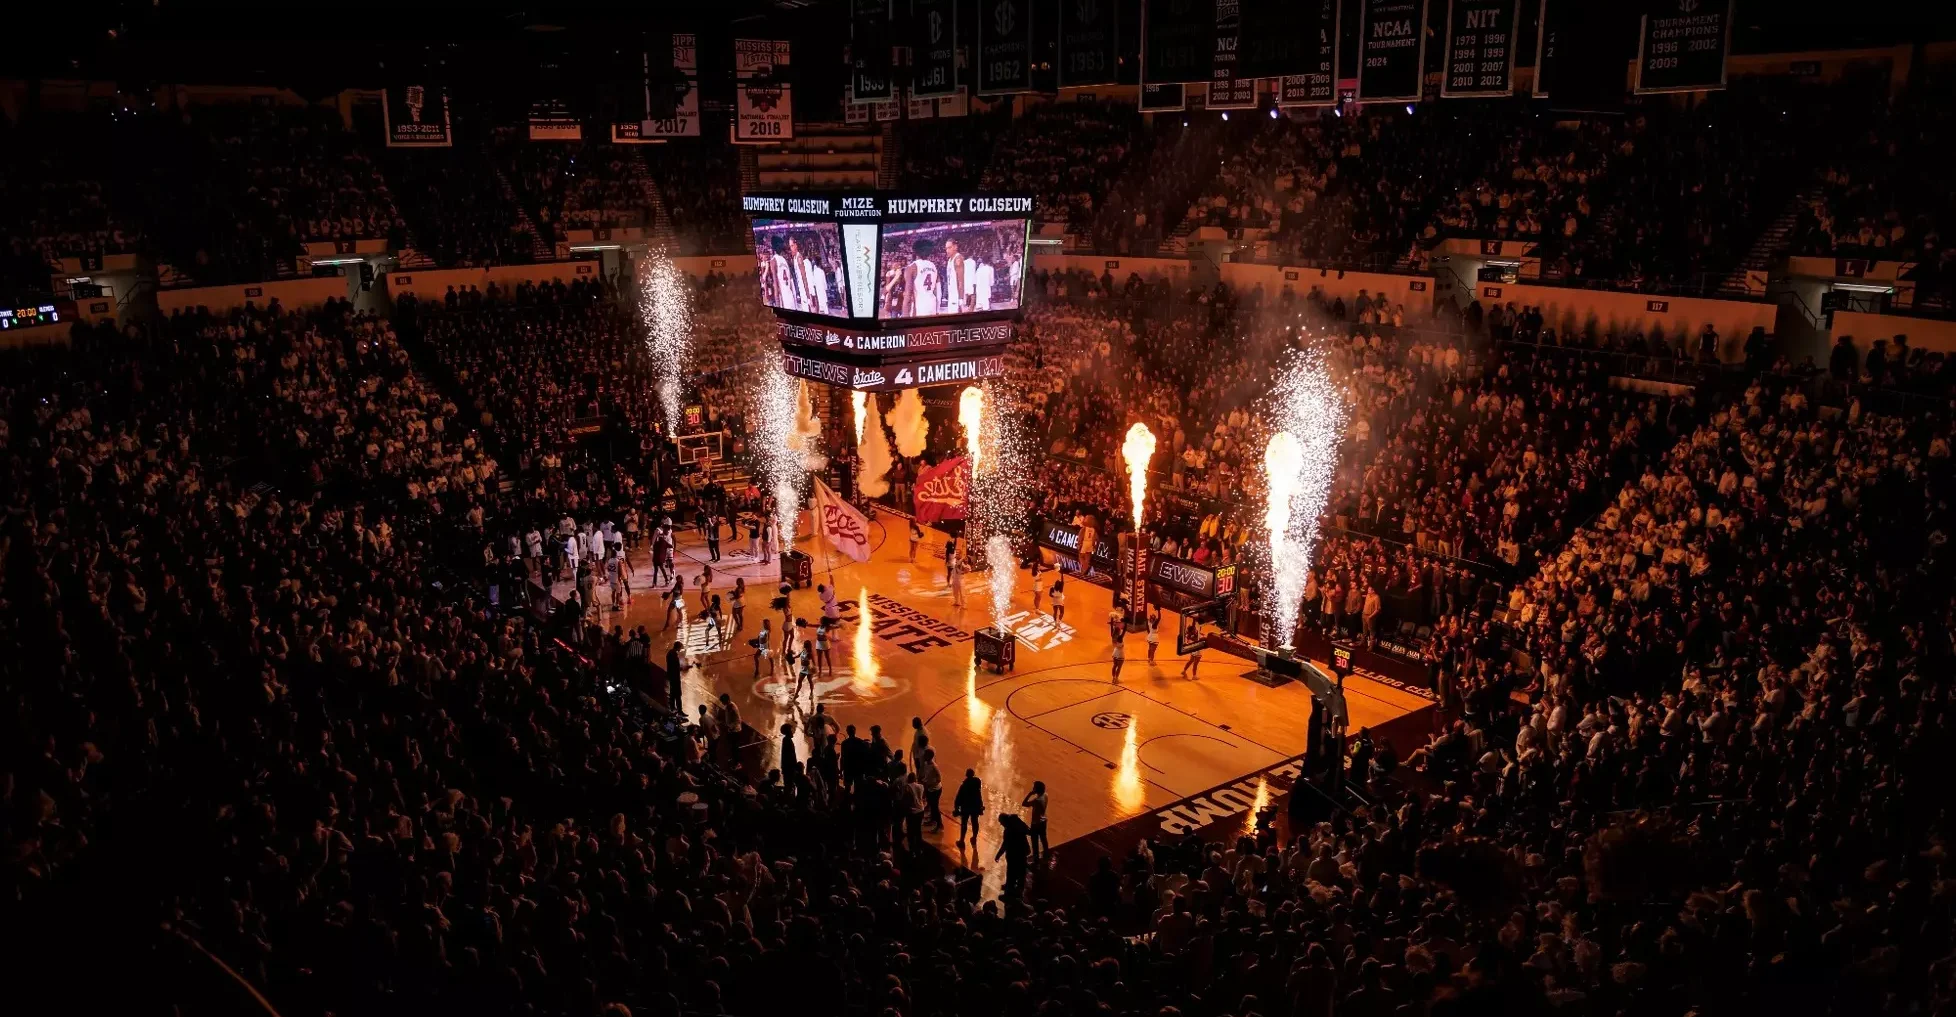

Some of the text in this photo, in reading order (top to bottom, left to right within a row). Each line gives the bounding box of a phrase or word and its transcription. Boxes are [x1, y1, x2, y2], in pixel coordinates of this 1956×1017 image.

[1466, 8, 1500, 29] NIT
[1652, 14, 1720, 29] TOURNAMENT
[1373, 19, 1412, 38] NCAA
[1652, 26, 1720, 40] CHAMPIONS
[1368, 38, 1416, 50] TOURNAMENT
[1455, 35, 1476, 46] 1979
[1688, 38, 1718, 52] 2002
[1366, 56, 1388, 67] 2024
[1453, 61, 1504, 73] 2001 2007
[988, 60, 1021, 82] 1962
[1452, 75, 1502, 87] 2010 2012
[654, 118, 687, 134] 2017
[750, 121, 781, 136] 2018
[743, 197, 830, 215] HUMPHREY COLISEUM
[842, 197, 874, 209] MIZE
[888, 197, 1032, 214] HUMPHREY COLISEUM
[834, 208, 882, 217] FOUNDATION
[1487, 242, 1495, 253] K
[1844, 261, 1854, 275] L
[923, 274, 933, 291] 4
[16, 307, 37, 318] 20:00
[1652, 302, 1663, 311] 117
[2, 319, 8, 328] 0
[52, 312, 58, 321] 0
[843, 335, 854, 349] 4
[857, 334, 905, 350] CAMERON
[907, 325, 1008, 348] MATTHEWS
[853, 367, 886, 390] State
[894, 368, 913, 385] 4
[918, 361, 976, 384] CAMERON
[688, 414, 700, 425] 30
[1048, 528, 1056, 541] 4
[1159, 561, 1208, 591] EWS
[1217, 566, 1235, 579] 20:00
[1136, 549, 1147, 613] HAIL STATE
[1217, 576, 1234, 595] 30
[867, 594, 975, 643] MISSISSIPPI
[1333, 647, 1350, 660] 20:00
[1335, 656, 1347, 669] 30
